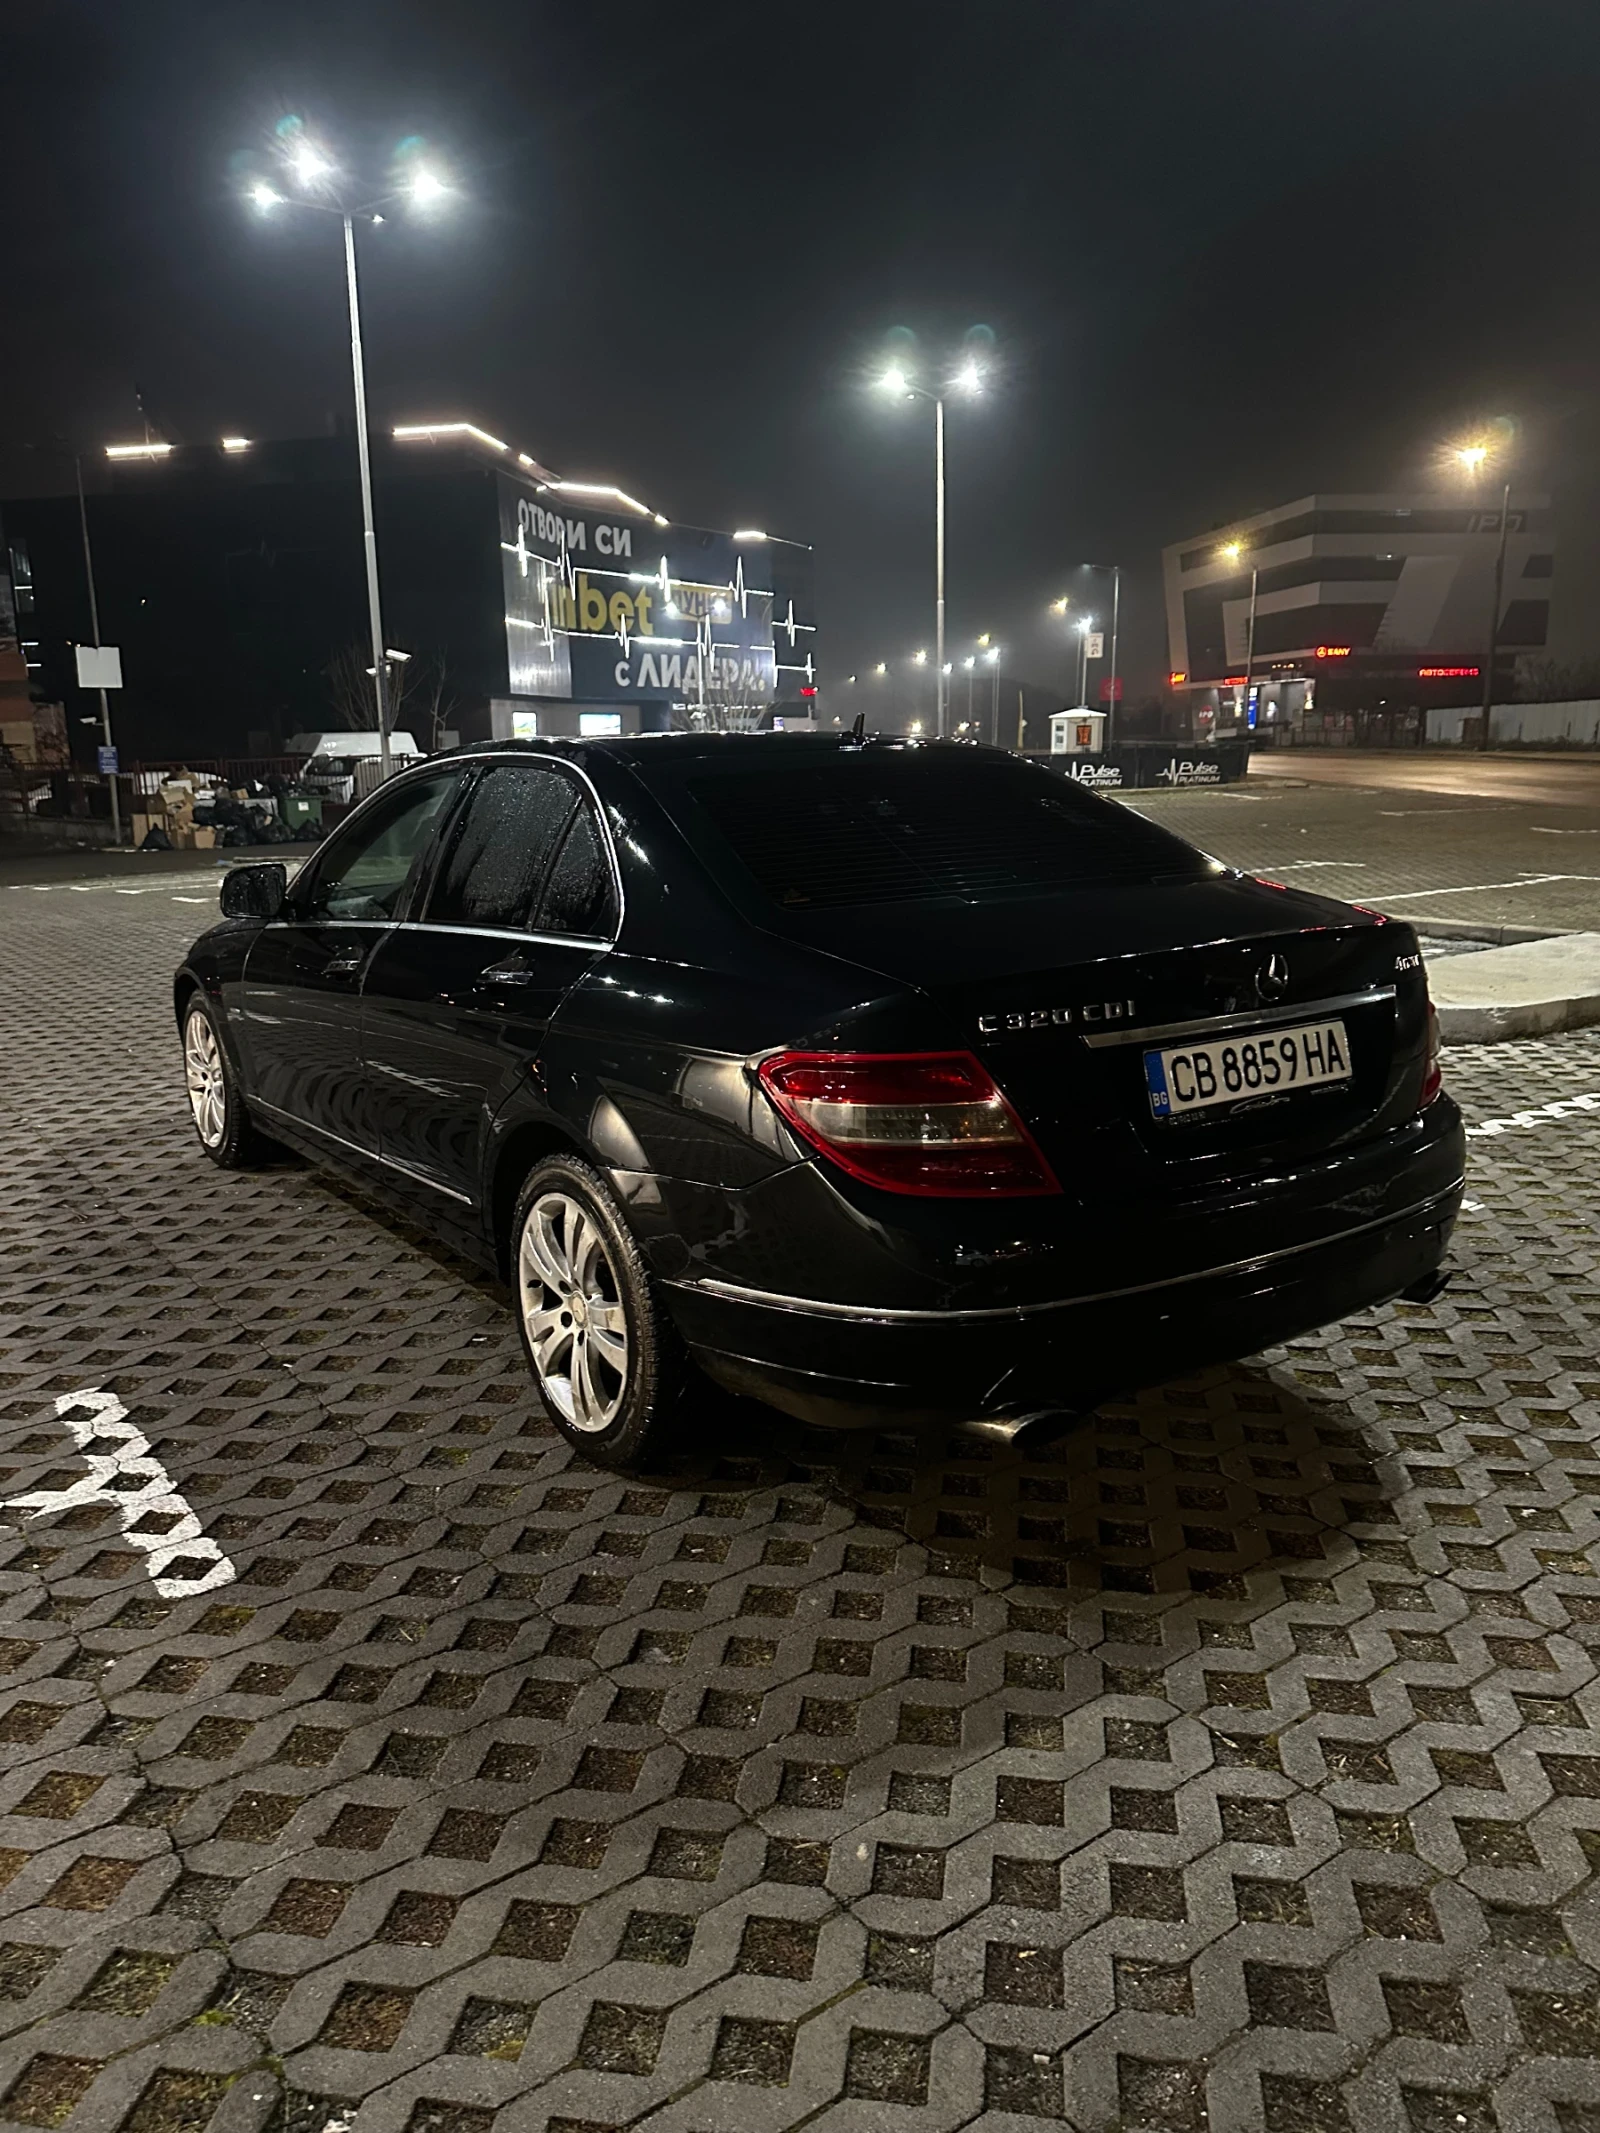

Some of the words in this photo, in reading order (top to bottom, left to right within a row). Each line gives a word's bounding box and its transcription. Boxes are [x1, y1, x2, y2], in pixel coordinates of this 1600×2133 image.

[517, 498, 587, 551] ОТВОРИ
[594, 524, 632, 557] СИ
[1080, 764, 1120, 777] Pulse
[1179, 761, 1219, 774] Pulse
[1080, 778, 1123, 787] PLATINUM
[1178, 775, 1221, 784] PLATINUM
[978, 1014, 999, 1033] C
[1006, 1008, 1072, 1029] 320
[1083, 999, 1135, 1021] CDI
[1221, 1036, 1298, 1093] 8859
[1152, 1091, 1169, 1107] BG
